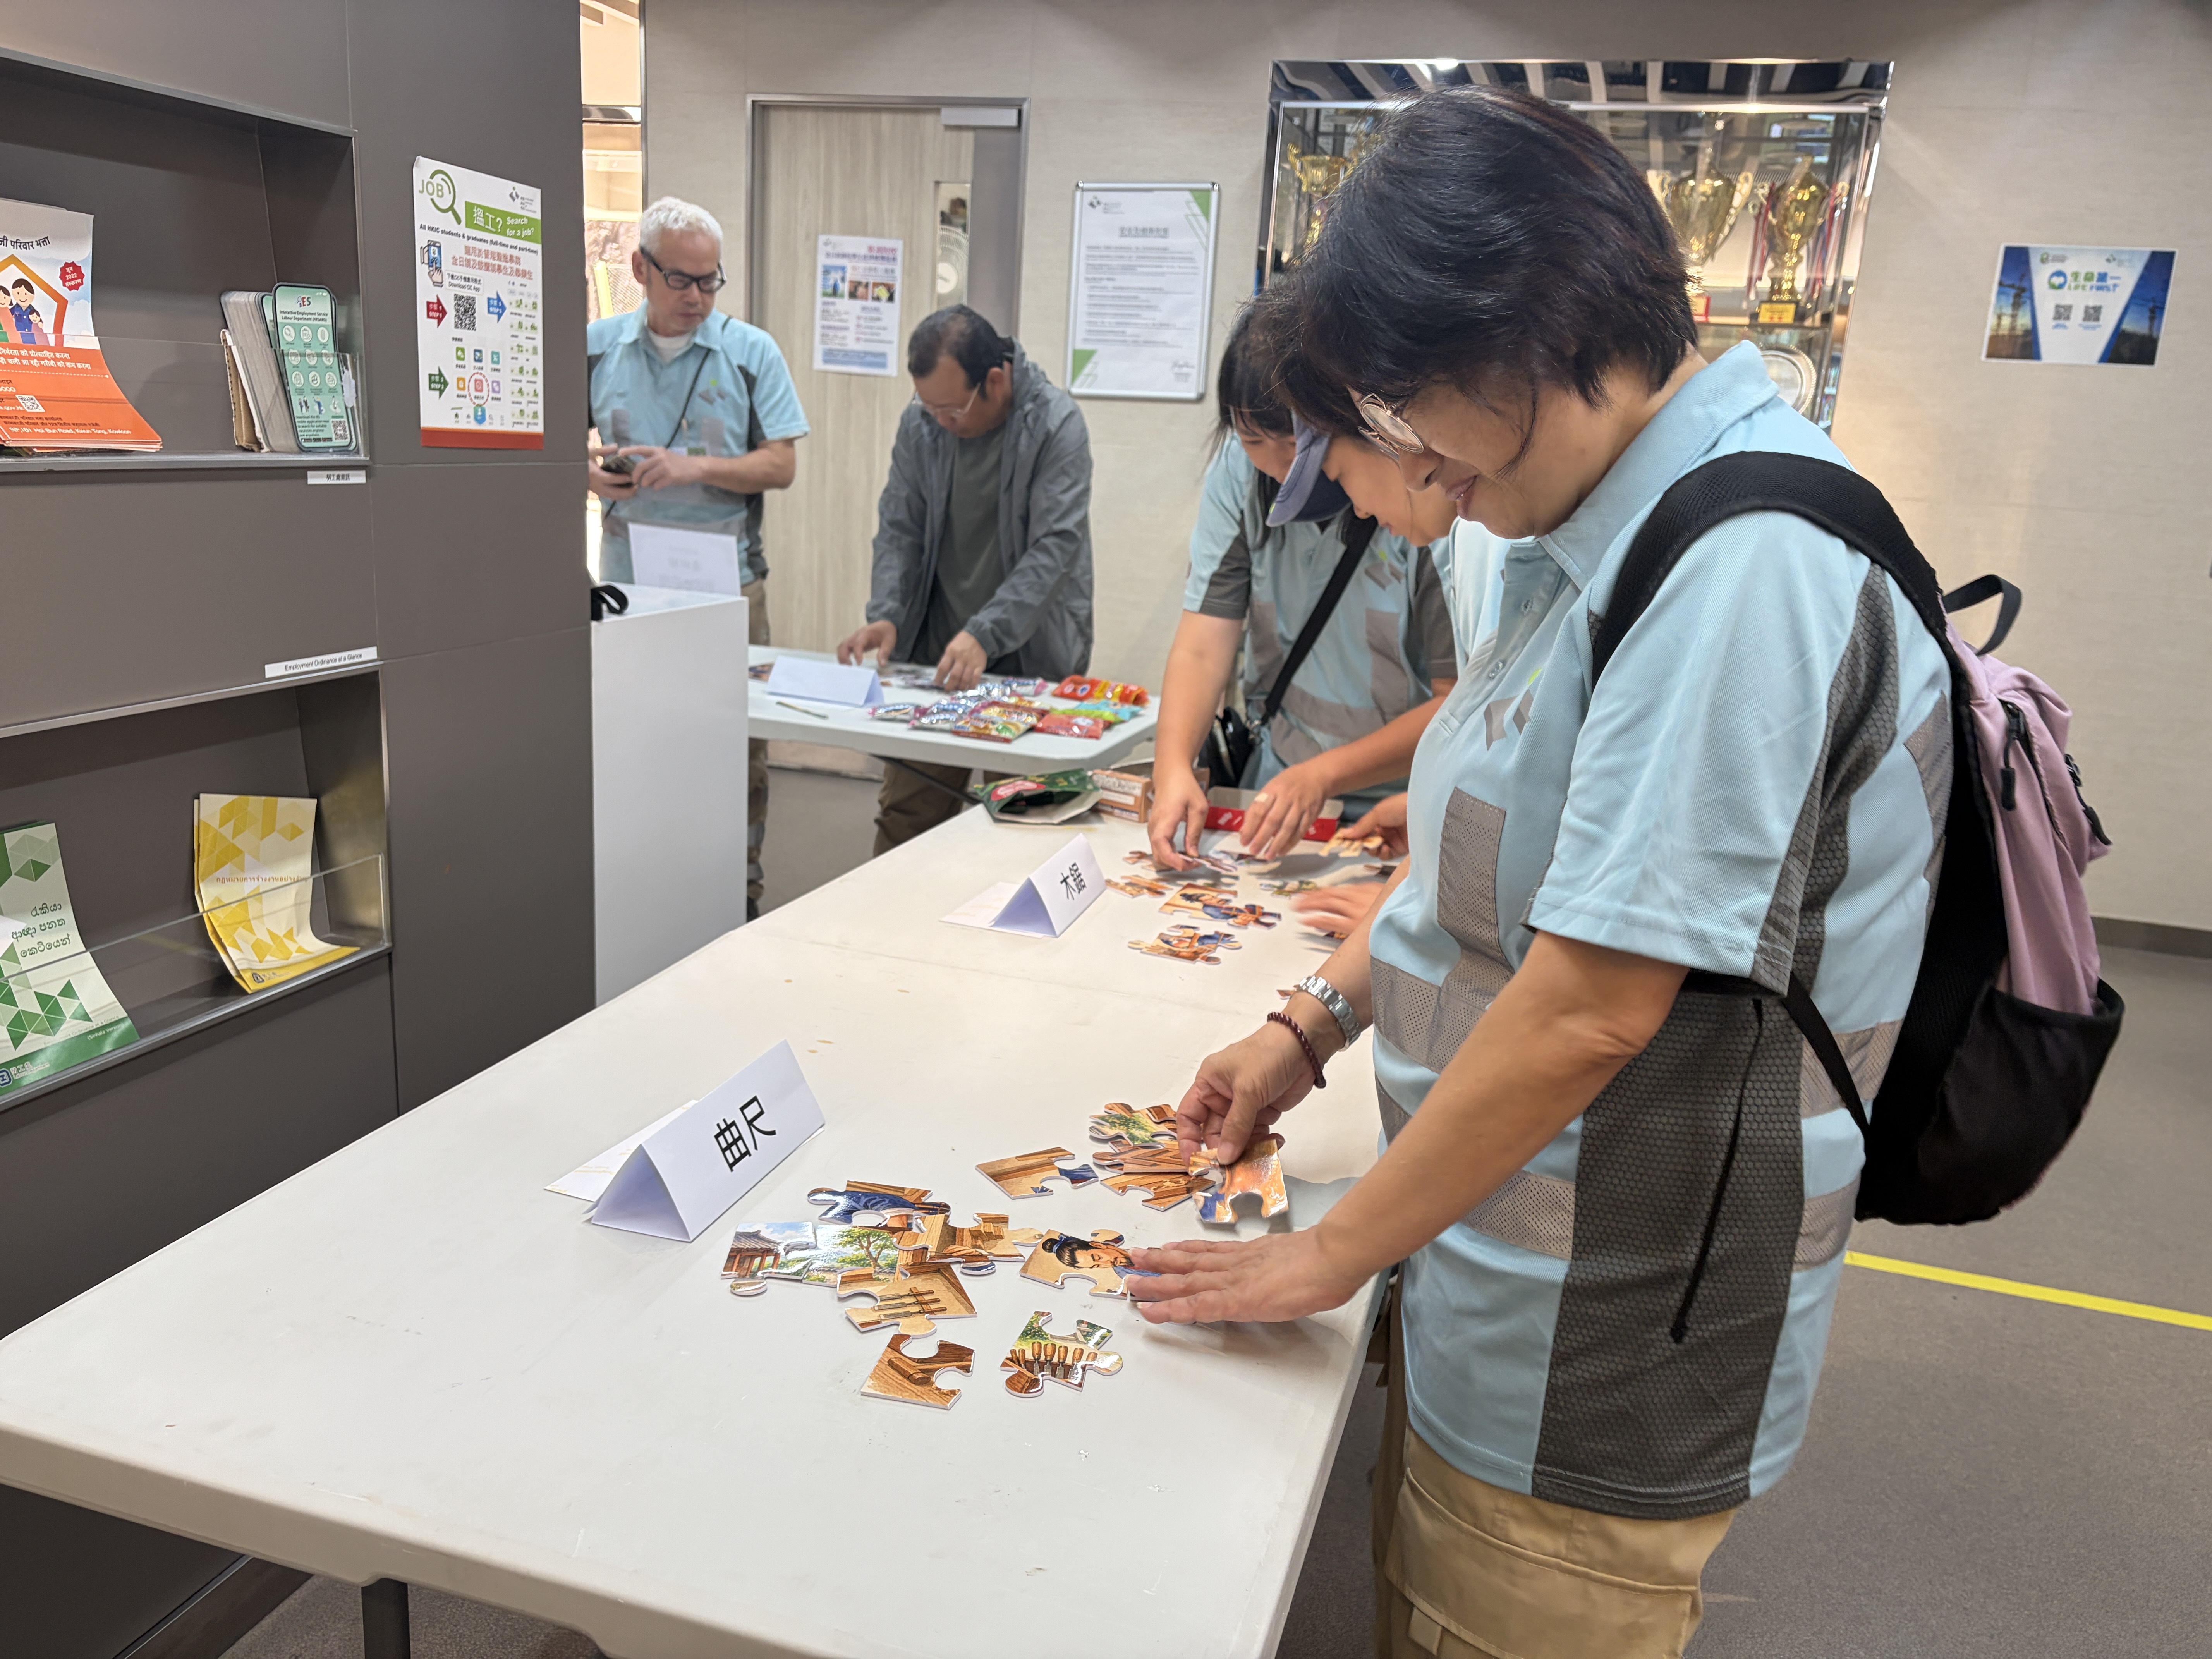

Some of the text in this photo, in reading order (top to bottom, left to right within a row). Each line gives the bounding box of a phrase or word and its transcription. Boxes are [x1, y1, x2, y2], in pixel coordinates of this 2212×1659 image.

[419, 180, 444, 198] JOB
[507, 216, 528, 225] Search
[441, 229, 461, 238] students
[467, 234, 489, 244] graduates
[522, 228, 534, 238] job?
[10, 239, 34, 250] परिवार
[36, 236, 50, 248] भत्ता
[285, 661, 313, 672] Employment
[314, 656, 337, 666] Ordinance
[1060, 862, 1087, 901] 木鋸
[713, 1095, 776, 1172] 曲尺
